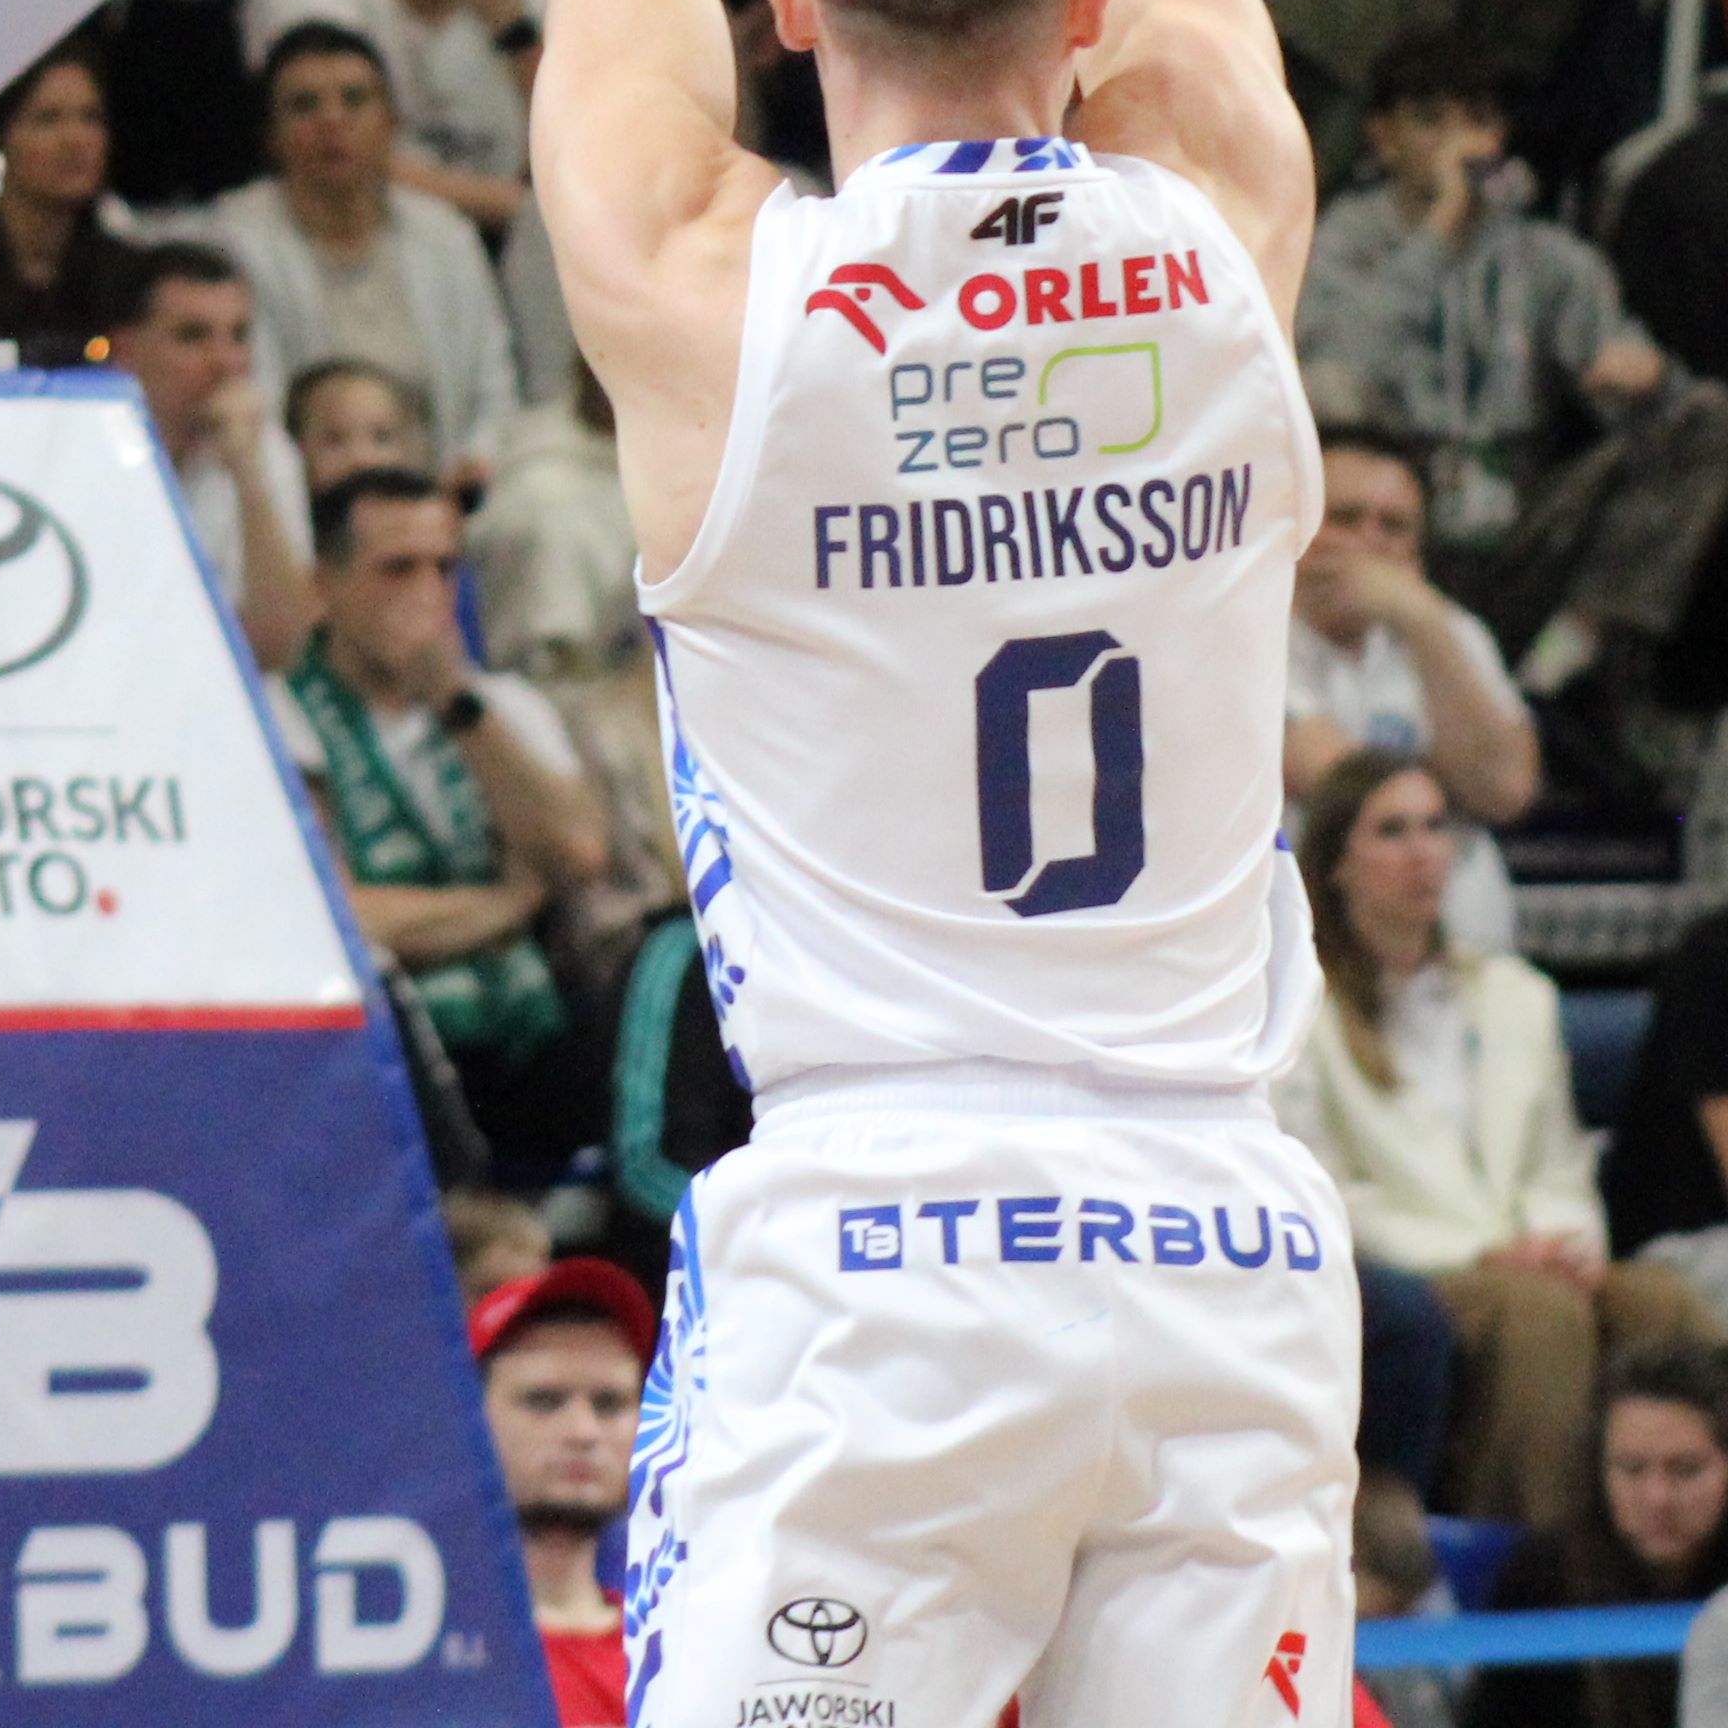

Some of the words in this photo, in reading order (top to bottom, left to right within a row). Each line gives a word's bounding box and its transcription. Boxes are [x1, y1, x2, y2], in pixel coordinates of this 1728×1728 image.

[970, 191, 1065, 247] 4F
[958, 249, 1210, 331] ORLEN
[891, 354, 1027, 421] pre
[896, 416, 1081, 475] zero
[813, 463, 1252, 590] FRIDRIKSSON
[974, 629, 1147, 919] 0
[915, 1197, 1323, 1272] TERBUD
[736, 1693, 895, 1728] JAWORSKI
